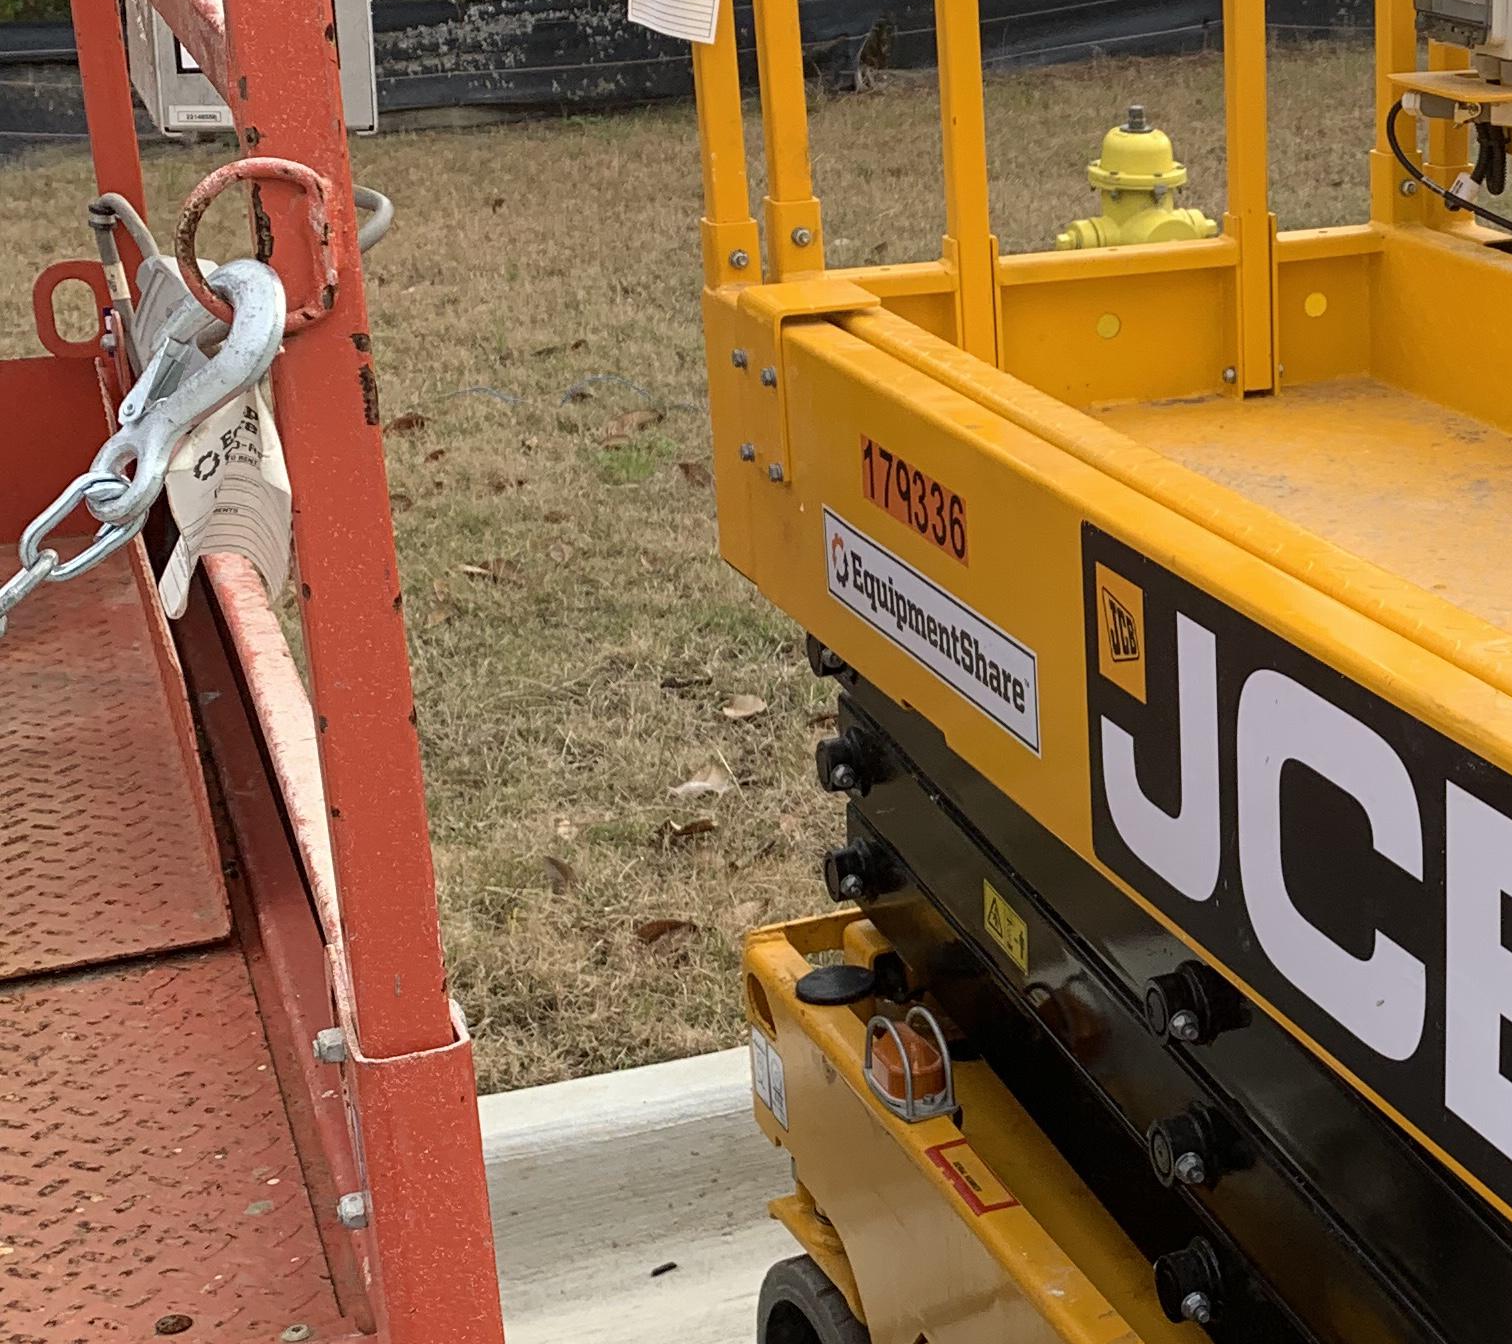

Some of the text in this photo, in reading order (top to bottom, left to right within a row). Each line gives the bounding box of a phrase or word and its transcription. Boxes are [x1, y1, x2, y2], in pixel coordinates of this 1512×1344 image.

[862, 439, 966, 559] 179336
[850, 550, 1026, 714] EquipmentShare
[1108, 597, 1137, 655] JCB
